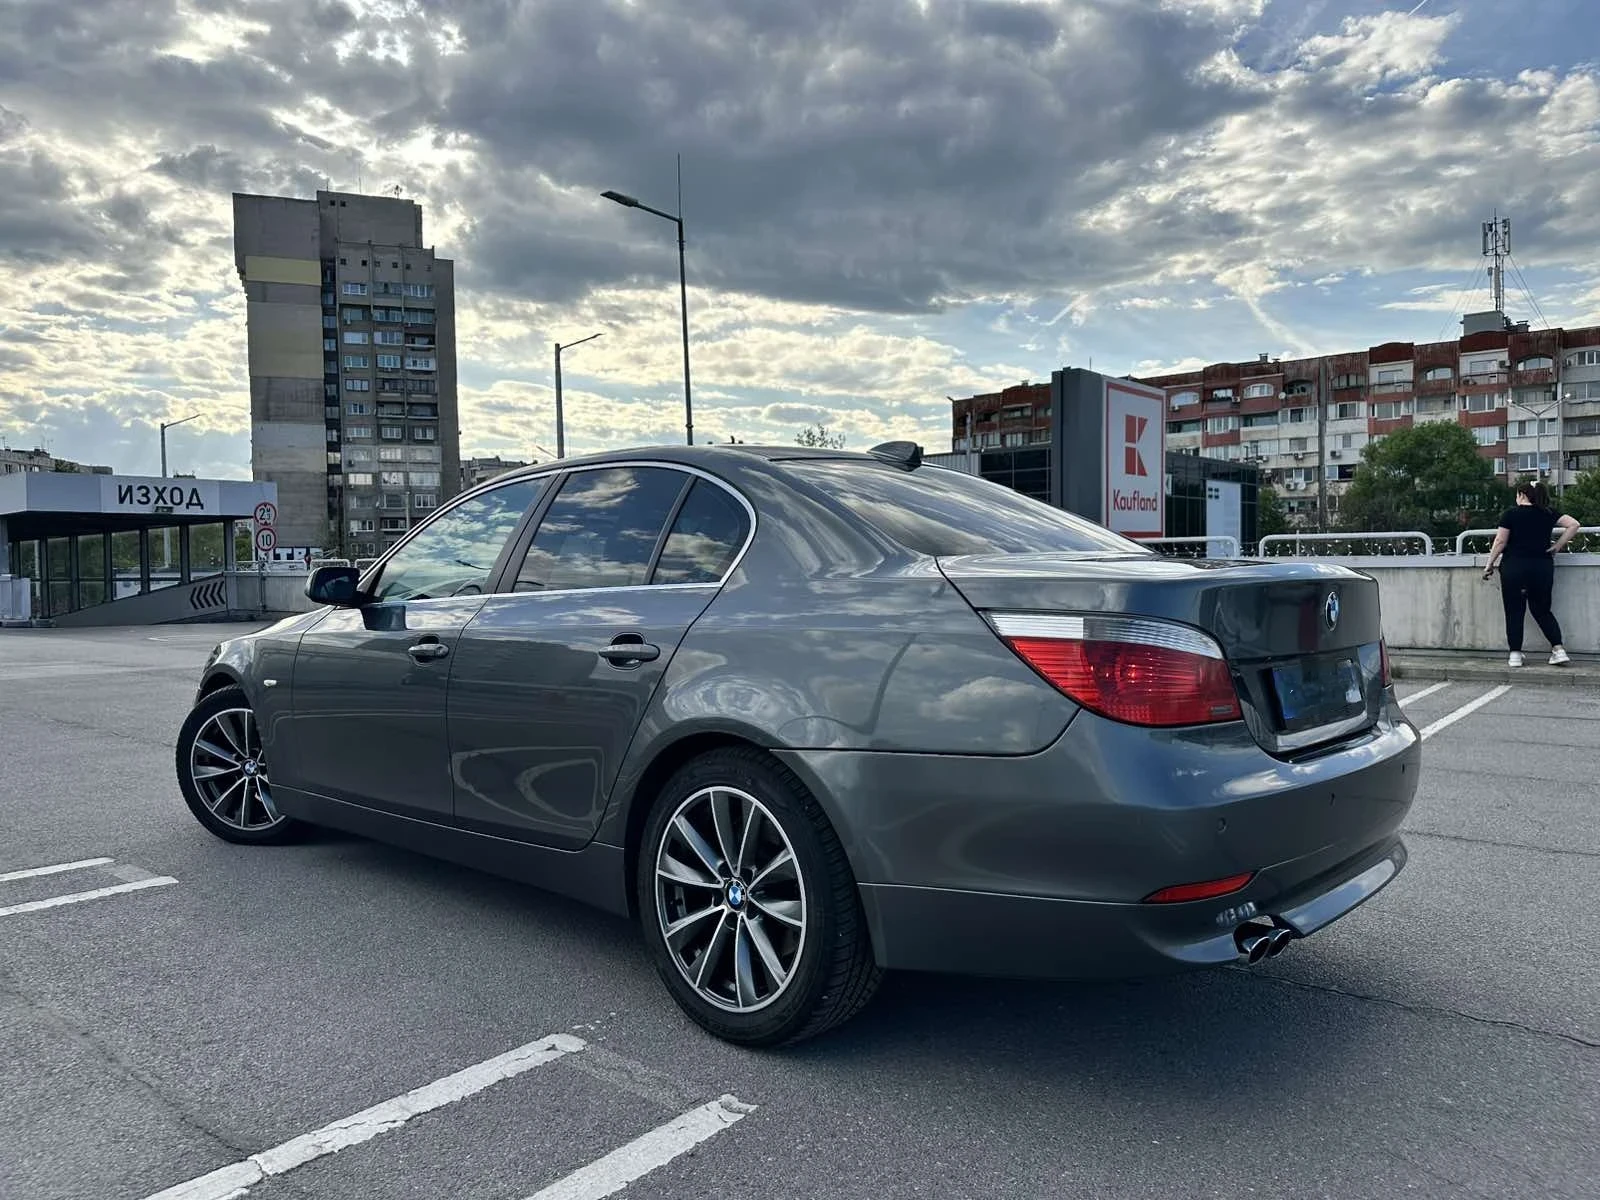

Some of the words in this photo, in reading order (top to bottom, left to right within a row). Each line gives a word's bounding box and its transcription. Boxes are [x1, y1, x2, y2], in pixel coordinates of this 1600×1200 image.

[118, 484, 204, 510] ИЗХОД
[1113, 488, 1158, 512] Kaufland
[261, 534, 272, 547] 10
